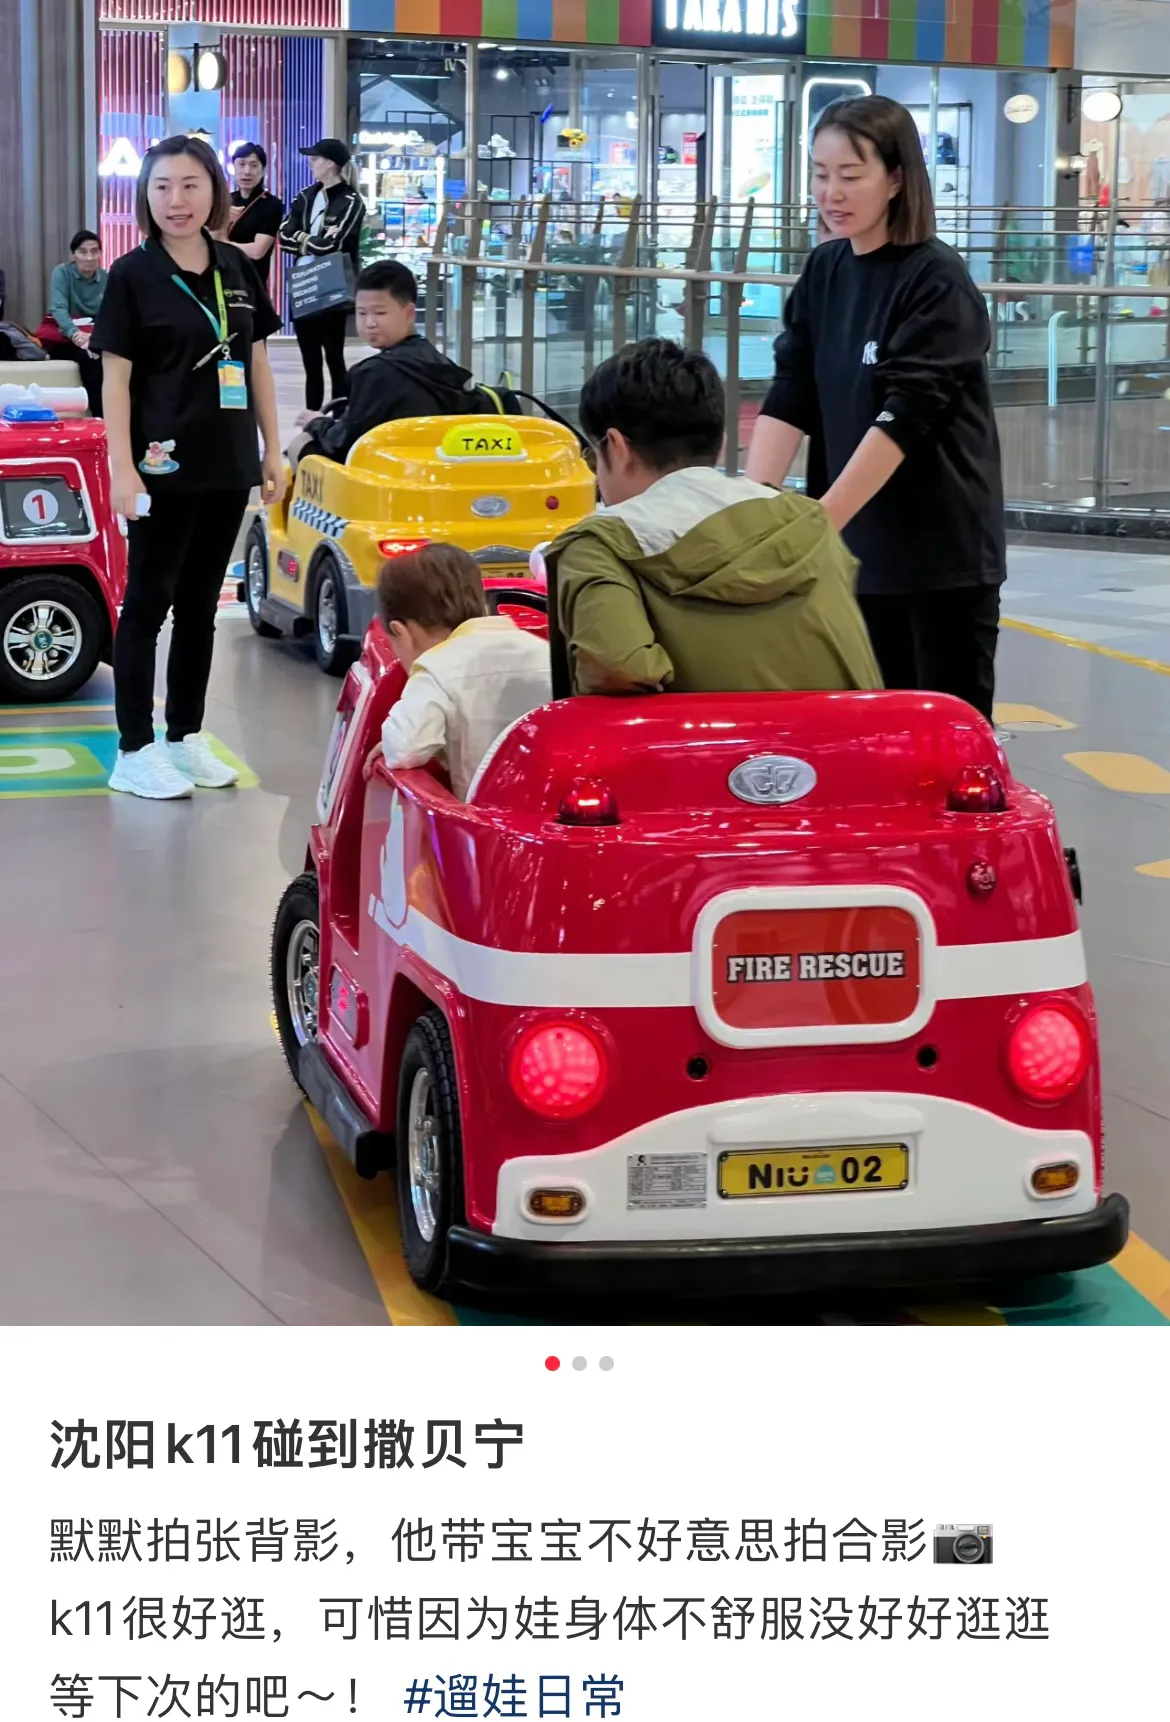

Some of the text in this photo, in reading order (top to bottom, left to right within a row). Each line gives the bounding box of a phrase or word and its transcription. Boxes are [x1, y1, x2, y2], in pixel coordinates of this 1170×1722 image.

[461, 437, 512, 451] TAXI
[301, 469, 323, 504] TAXI
[31, 494, 46, 520] 1
[727, 951, 905, 982] FIRE RESCUE
[840, 1155, 883, 1184] 02
